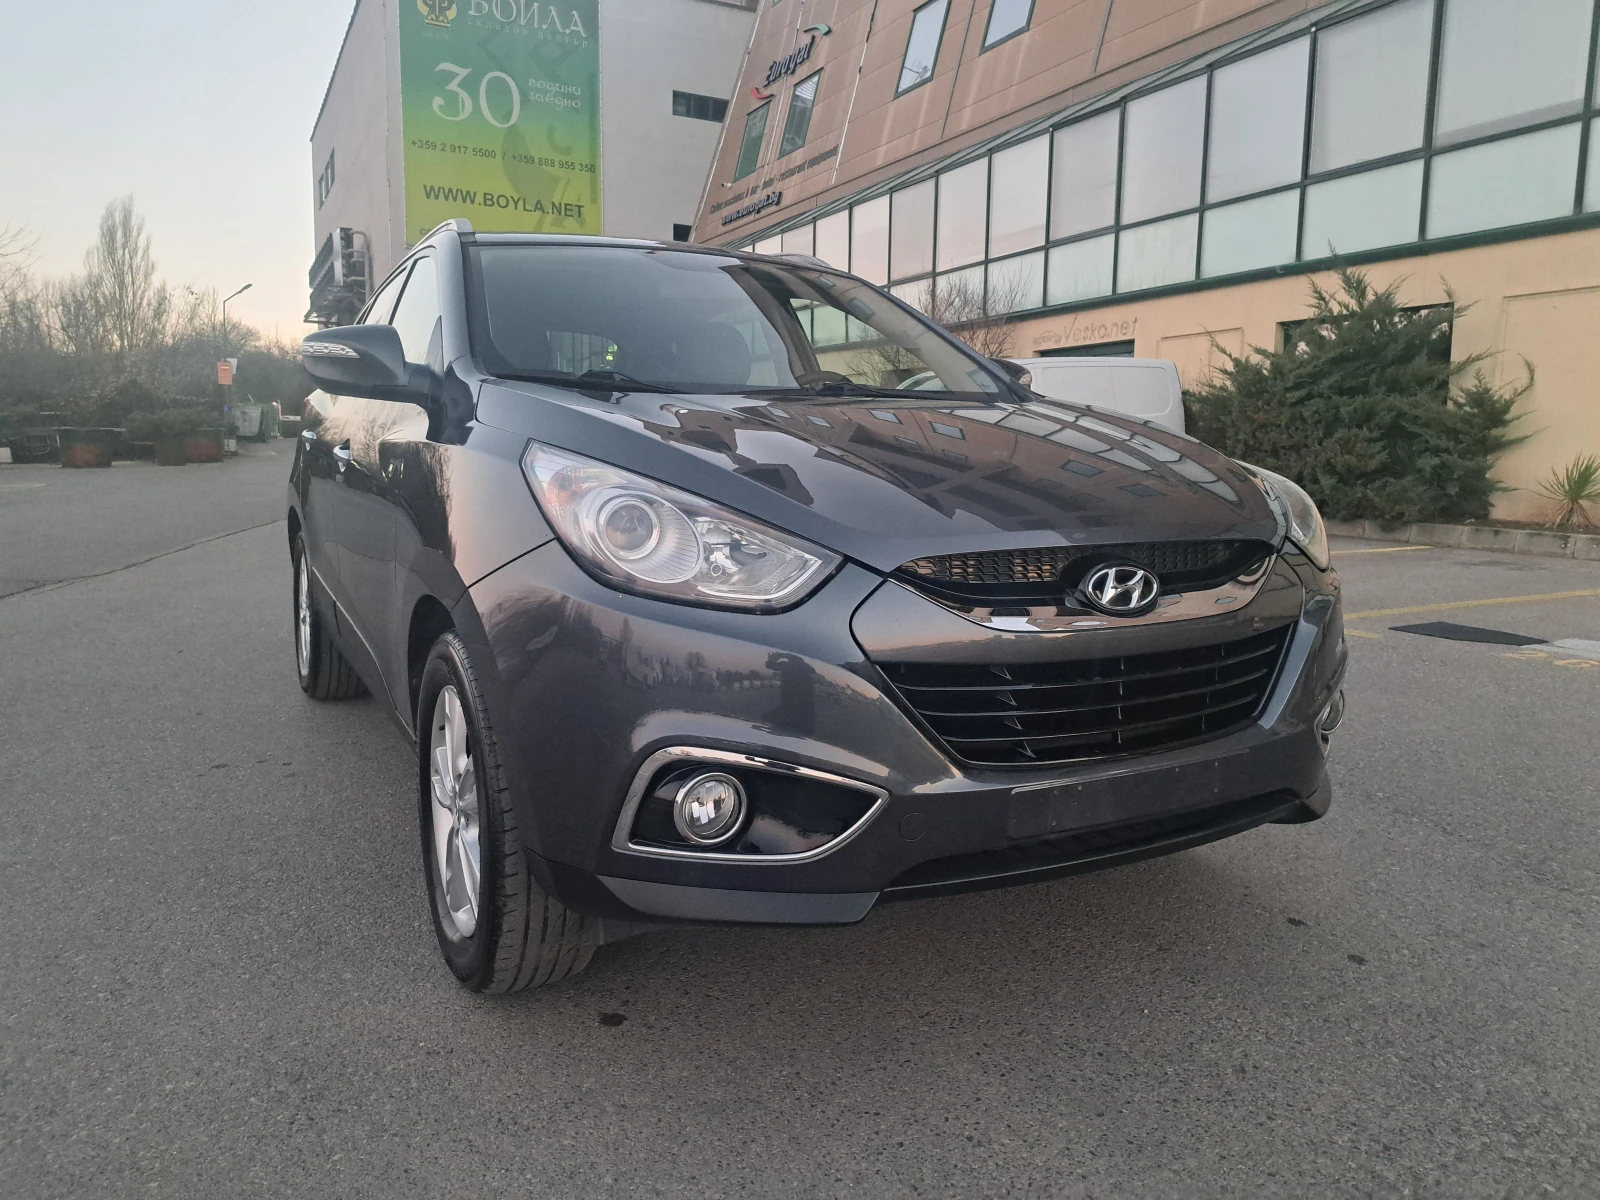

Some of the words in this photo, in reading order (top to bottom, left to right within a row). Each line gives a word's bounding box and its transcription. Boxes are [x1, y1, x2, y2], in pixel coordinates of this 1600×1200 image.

[432, 62, 521, 128] 30
[411, 139, 437, 151] +359
[440, 142, 447, 152] 2
[449, 143, 468, 155] 917
[472, 147, 497, 159] 5500
[511, 153, 535, 165] +359
[538, 157, 556, 168] 888
[558, 160, 576, 171] 955
[578, 162, 596, 173] 350
[423, 184, 585, 219] WWW.BOYLA.NET
